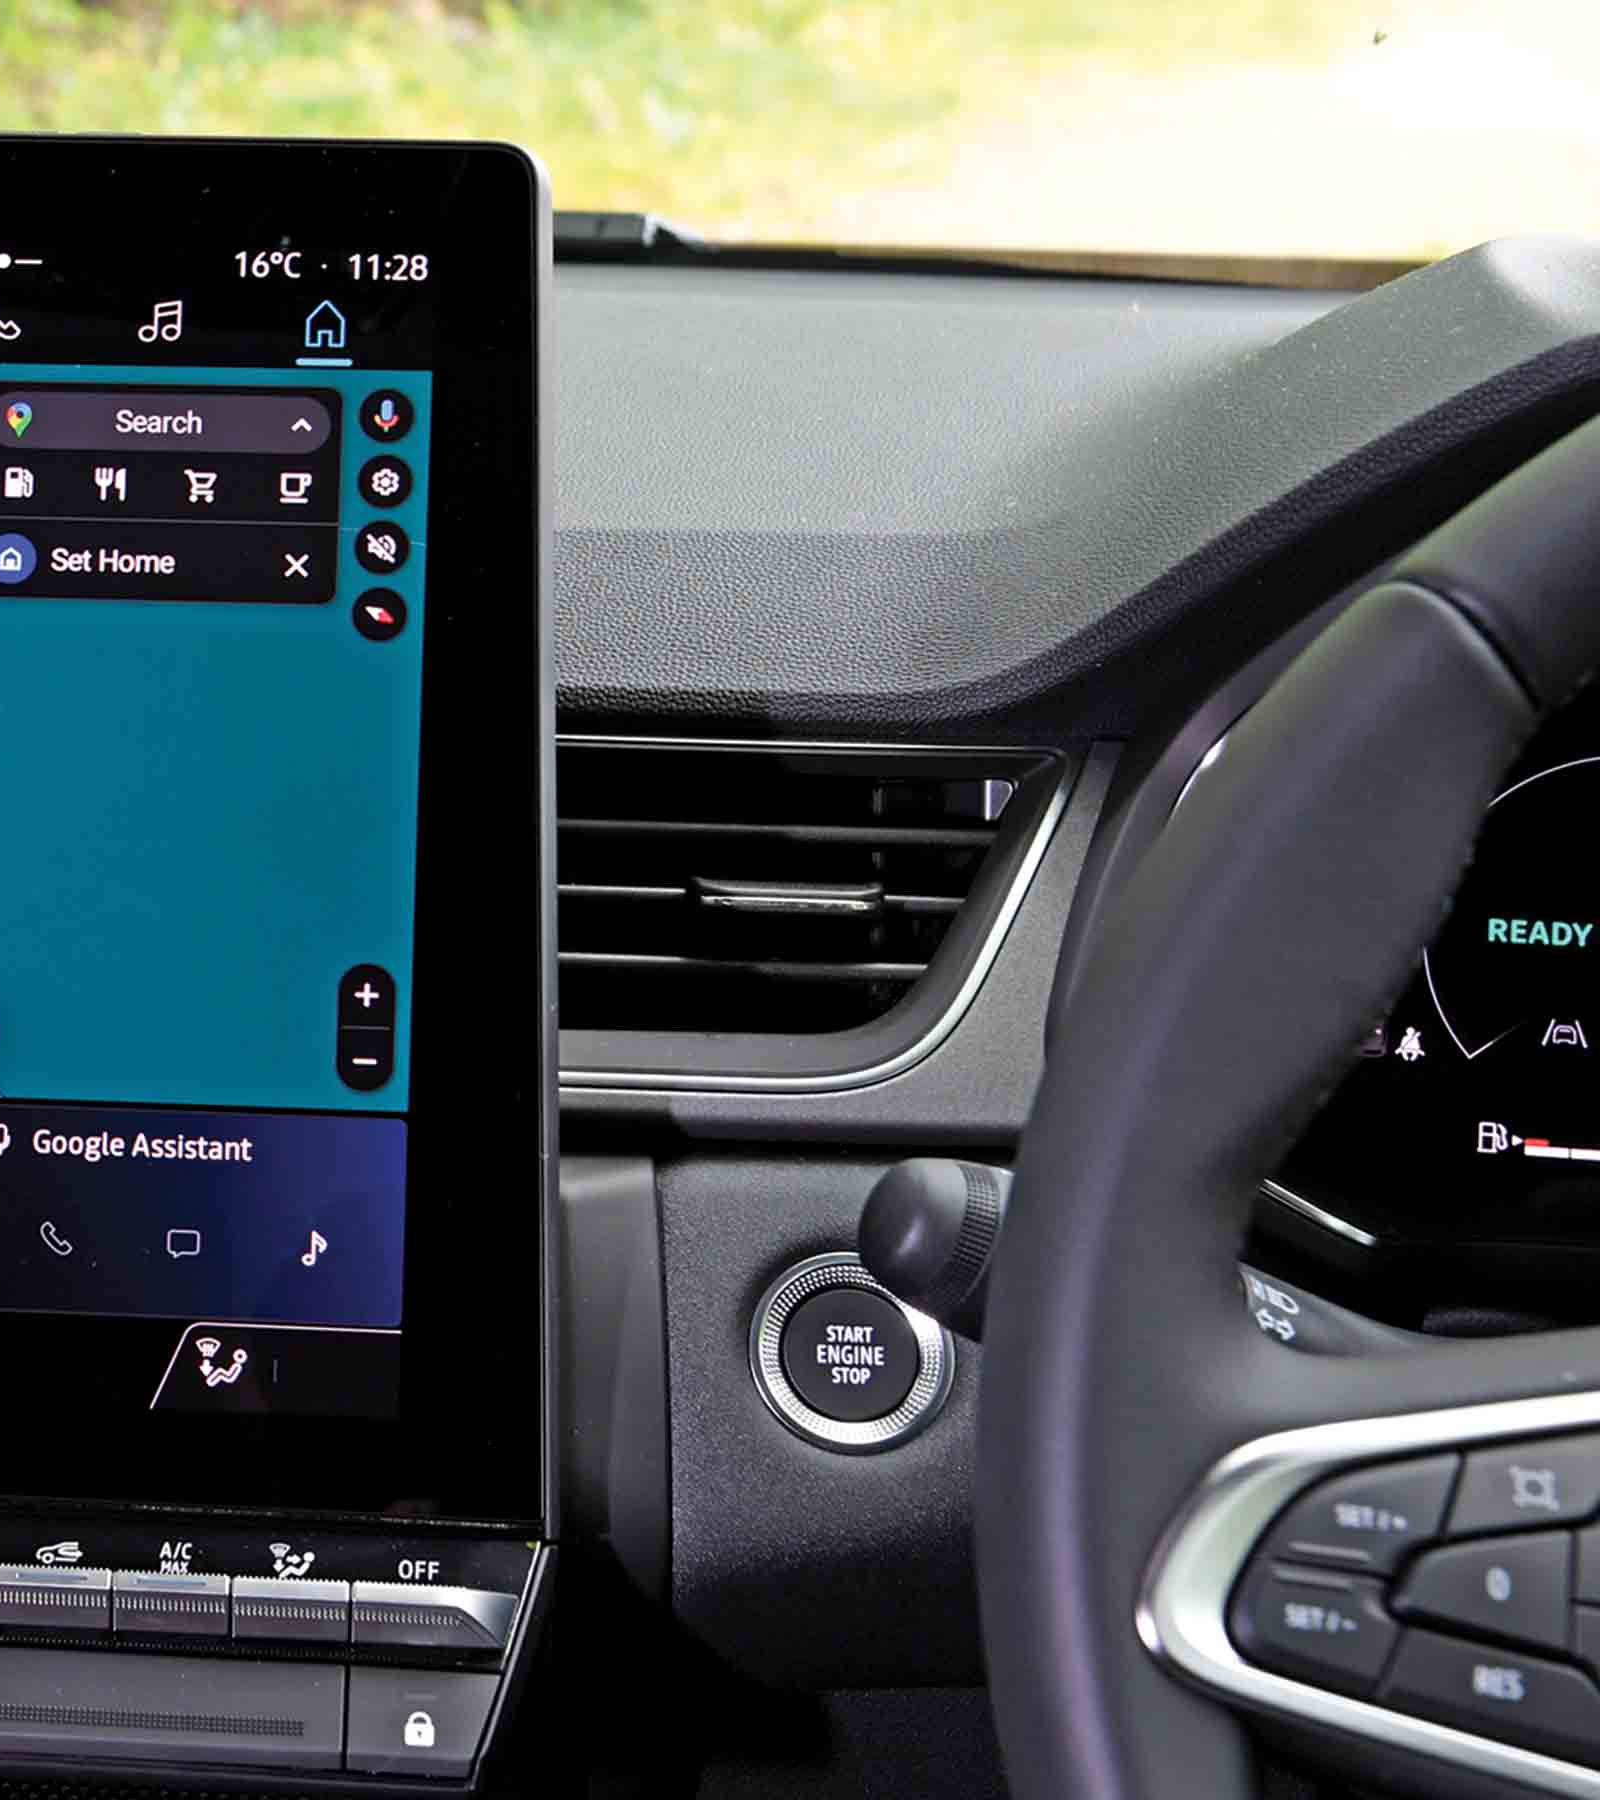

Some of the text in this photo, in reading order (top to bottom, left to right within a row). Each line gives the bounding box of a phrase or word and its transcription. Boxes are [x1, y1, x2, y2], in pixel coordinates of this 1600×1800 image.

[350, 252, 430, 284] 11:28
[115, 408, 203, 437] Search
[51, 547, 176, 577] Set Home
[1487, 917, 1594, 949] READY
[33, 1129, 253, 1162] Google Assistant
[826, 1325, 873, 1343] START
[816, 1344, 885, 1366] ENGINE
[831, 1367, 871, 1385] STOP
[159, 1541, 193, 1562] A/C
[160, 1559, 189, 1574] MAX
[398, 1559, 441, 1581] OFF
